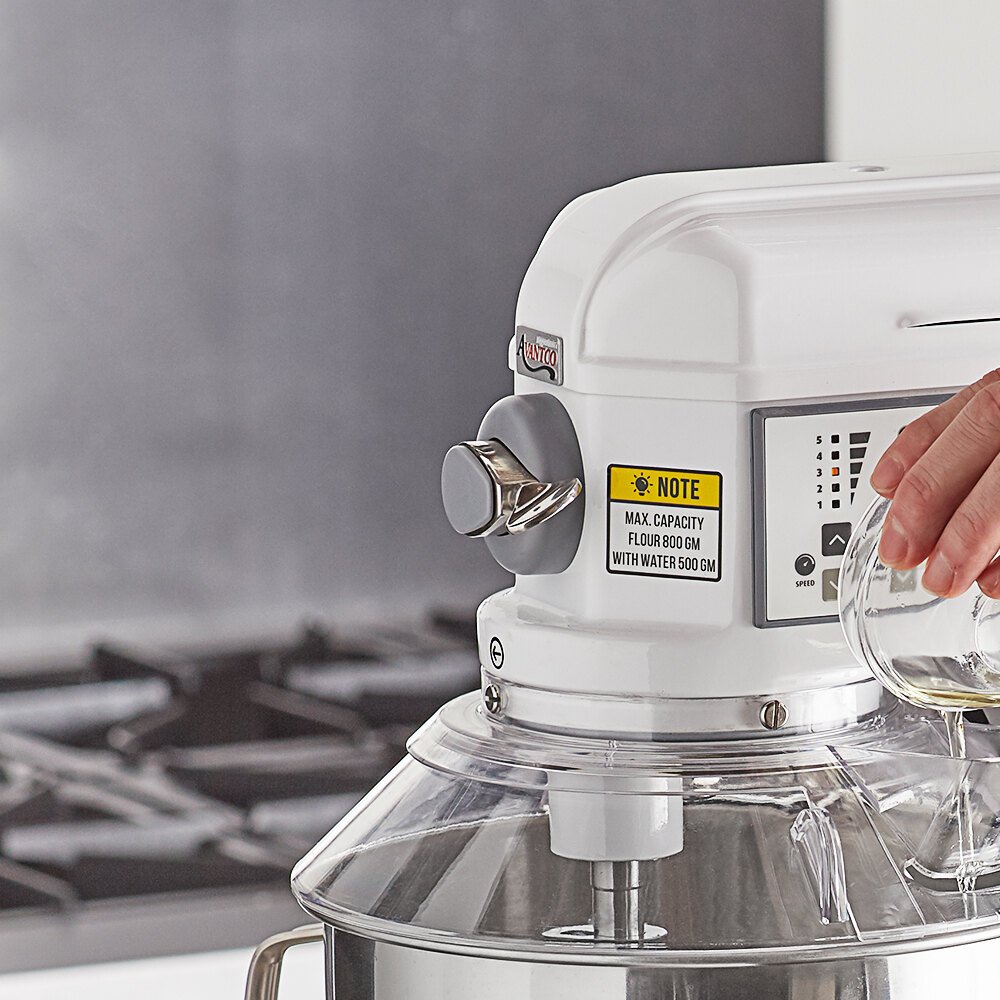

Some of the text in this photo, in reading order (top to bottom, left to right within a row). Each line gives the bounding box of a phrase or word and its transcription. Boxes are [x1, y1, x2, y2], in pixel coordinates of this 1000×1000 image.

[517, 334, 557, 376] AVANTCO
[816, 436, 822, 444] 5
[816, 452, 822, 460] 4
[816, 468, 822, 477] 3
[658, 476, 700, 500] NOTE
[816, 485, 822, 493] 2
[817, 501, 822, 509] 1
[625, 511, 704, 530] MAX. CAPACITY
[628, 532, 700, 550] FLOUR 800 GM
[612, 551, 716, 572] WITH WATER 500 GM
[795, 580, 815, 588] SPEED
